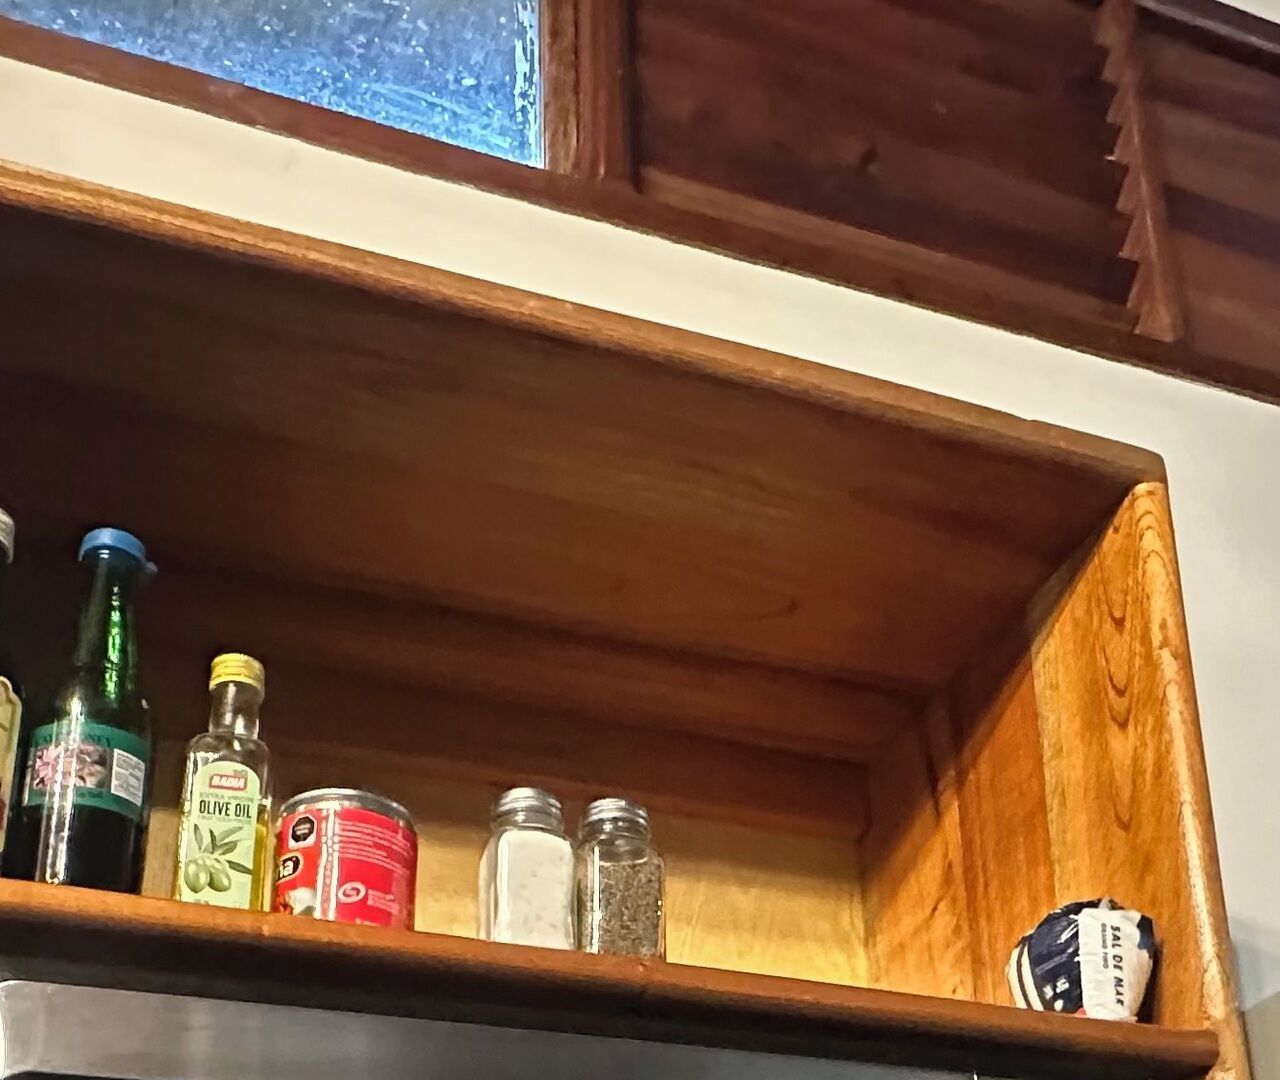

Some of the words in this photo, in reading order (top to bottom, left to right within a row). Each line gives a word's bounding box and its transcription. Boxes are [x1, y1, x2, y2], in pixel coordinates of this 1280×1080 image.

[199, 800, 231, 816] OLIVE
[235, 803, 252, 819] OIL
[1111, 925, 1122, 948] SAL
[1112, 954, 1124, 971] DE
[1113, 976, 1125, 1007] MAR
